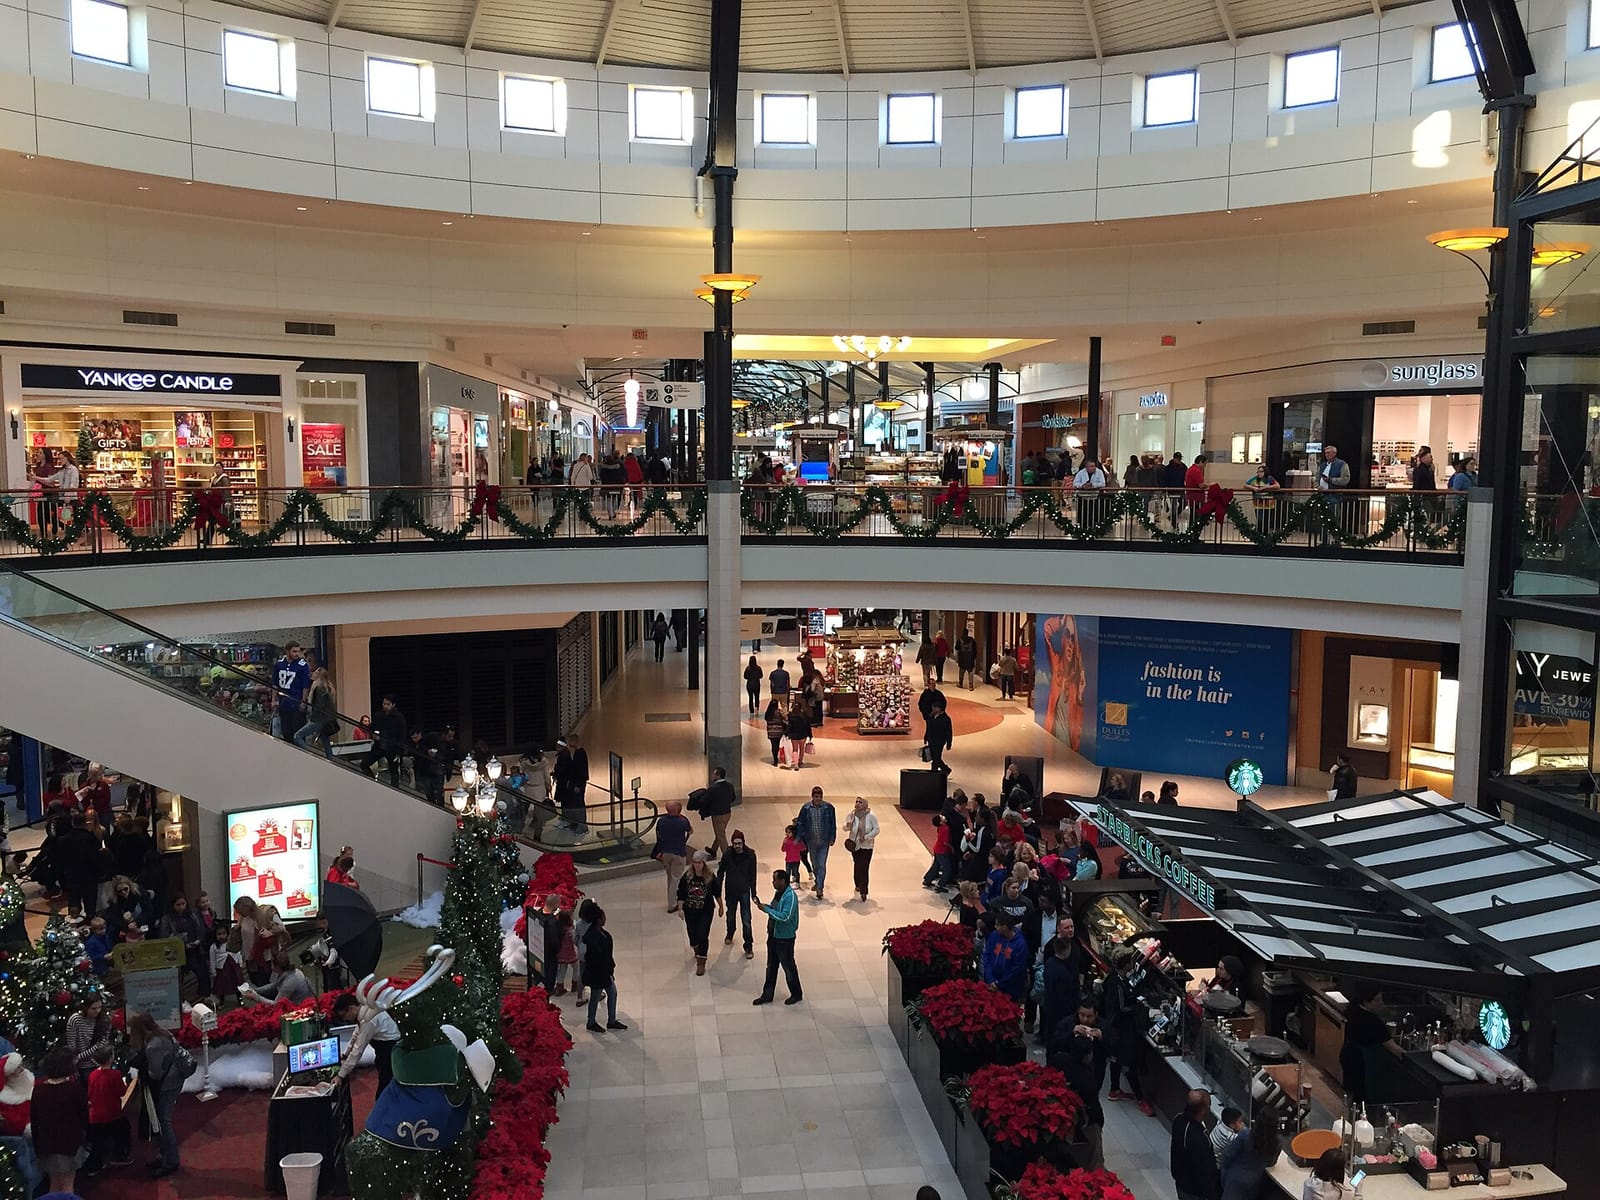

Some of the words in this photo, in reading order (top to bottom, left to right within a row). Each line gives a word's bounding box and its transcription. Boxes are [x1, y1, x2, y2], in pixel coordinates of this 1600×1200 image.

[1391, 359, 1477, 385] sunglass
[97, 439, 127, 448] GIFTS
[306, 444, 342, 456] SALE
[279, 670, 296, 689] 87
[1140, 661, 1203, 681] fashion
[1207, 666, 1221, 682] is
[1146, 681, 1162, 698] in
[1166, 683, 1193, 700] the
[1196, 685, 1233, 704] hair
[1359, 686, 1386, 696] KAY
[1096, 804, 1161, 869] STARBUCKS
[1163, 855, 1216, 911] COFFEE
